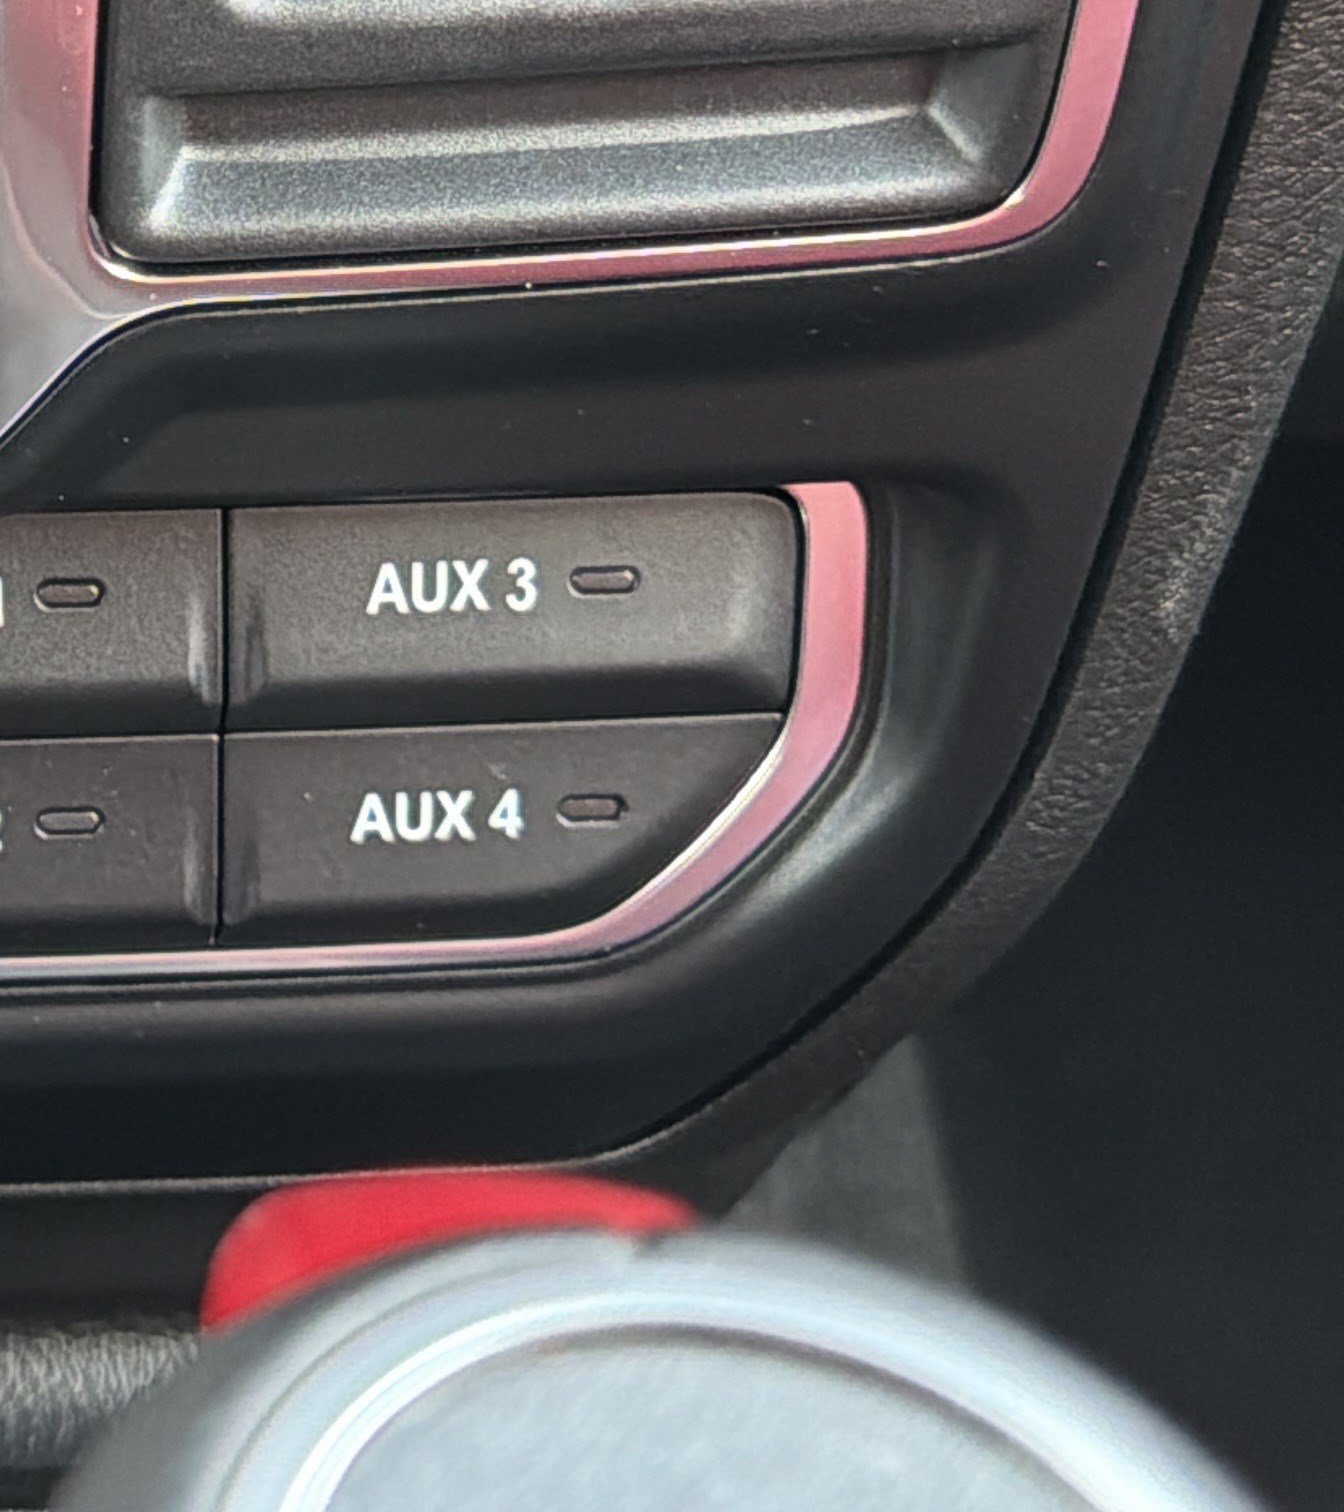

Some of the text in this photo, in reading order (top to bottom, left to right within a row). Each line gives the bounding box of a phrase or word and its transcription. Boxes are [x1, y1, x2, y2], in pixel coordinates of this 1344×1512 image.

[365, 557, 539, 615] AUX 3
[350, 788, 525, 845] AUX 4
